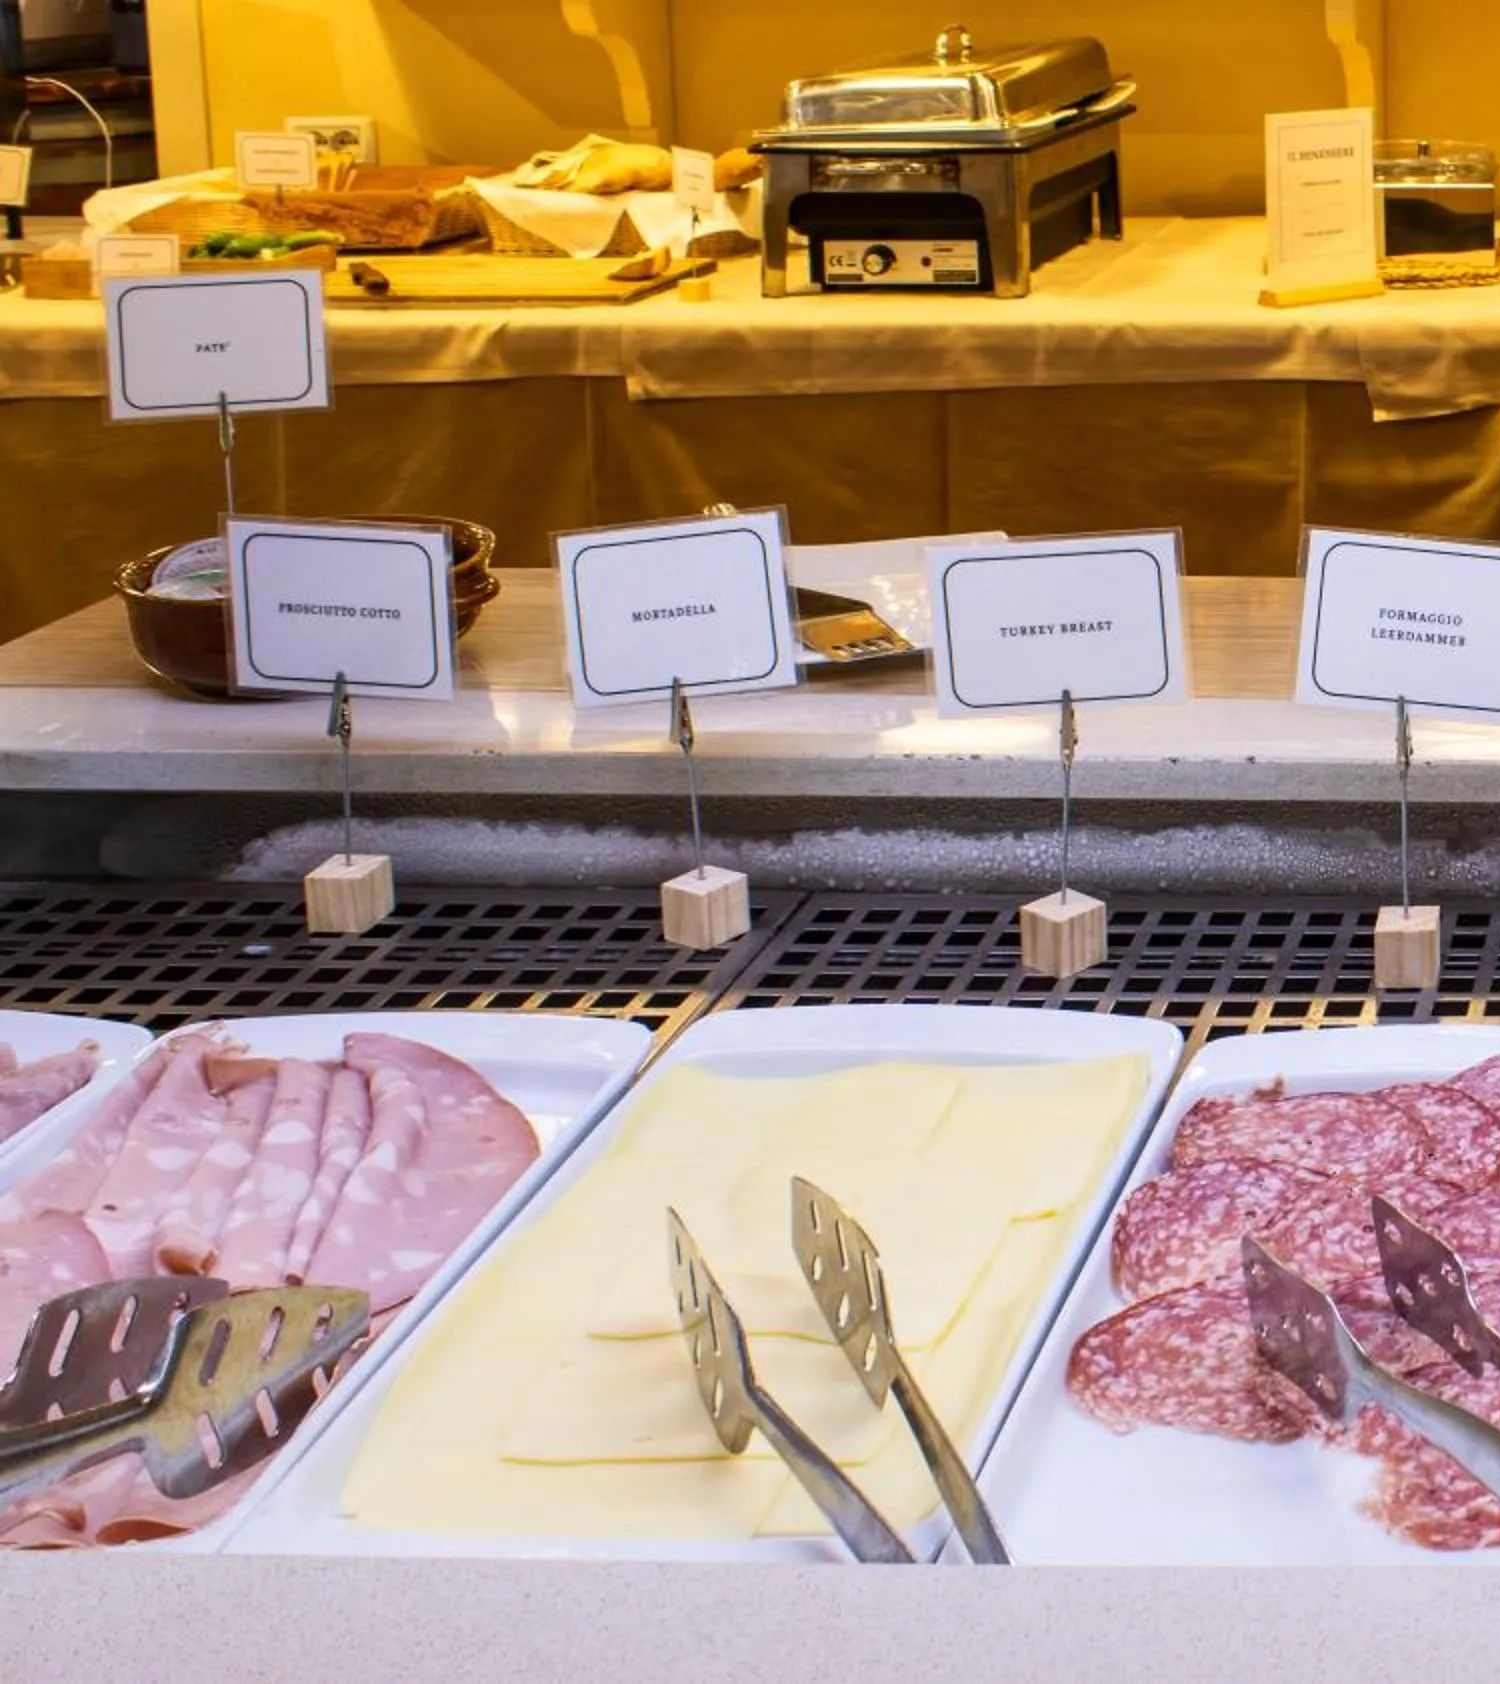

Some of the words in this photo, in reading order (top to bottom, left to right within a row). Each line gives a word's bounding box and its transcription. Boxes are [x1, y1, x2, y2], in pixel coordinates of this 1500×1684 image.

[279, 602, 357, 618] PROSCIUTTO
[360, 607, 401, 620] COTTO
[632, 603, 717, 622] MORTADELLA
[1378, 608, 1463, 626] FORMAGGIO
[1000, 623, 1055, 638] TURKEY
[1060, 620, 1112, 634] BREAST
[1371, 627, 1466, 647] LEERDAMMER
